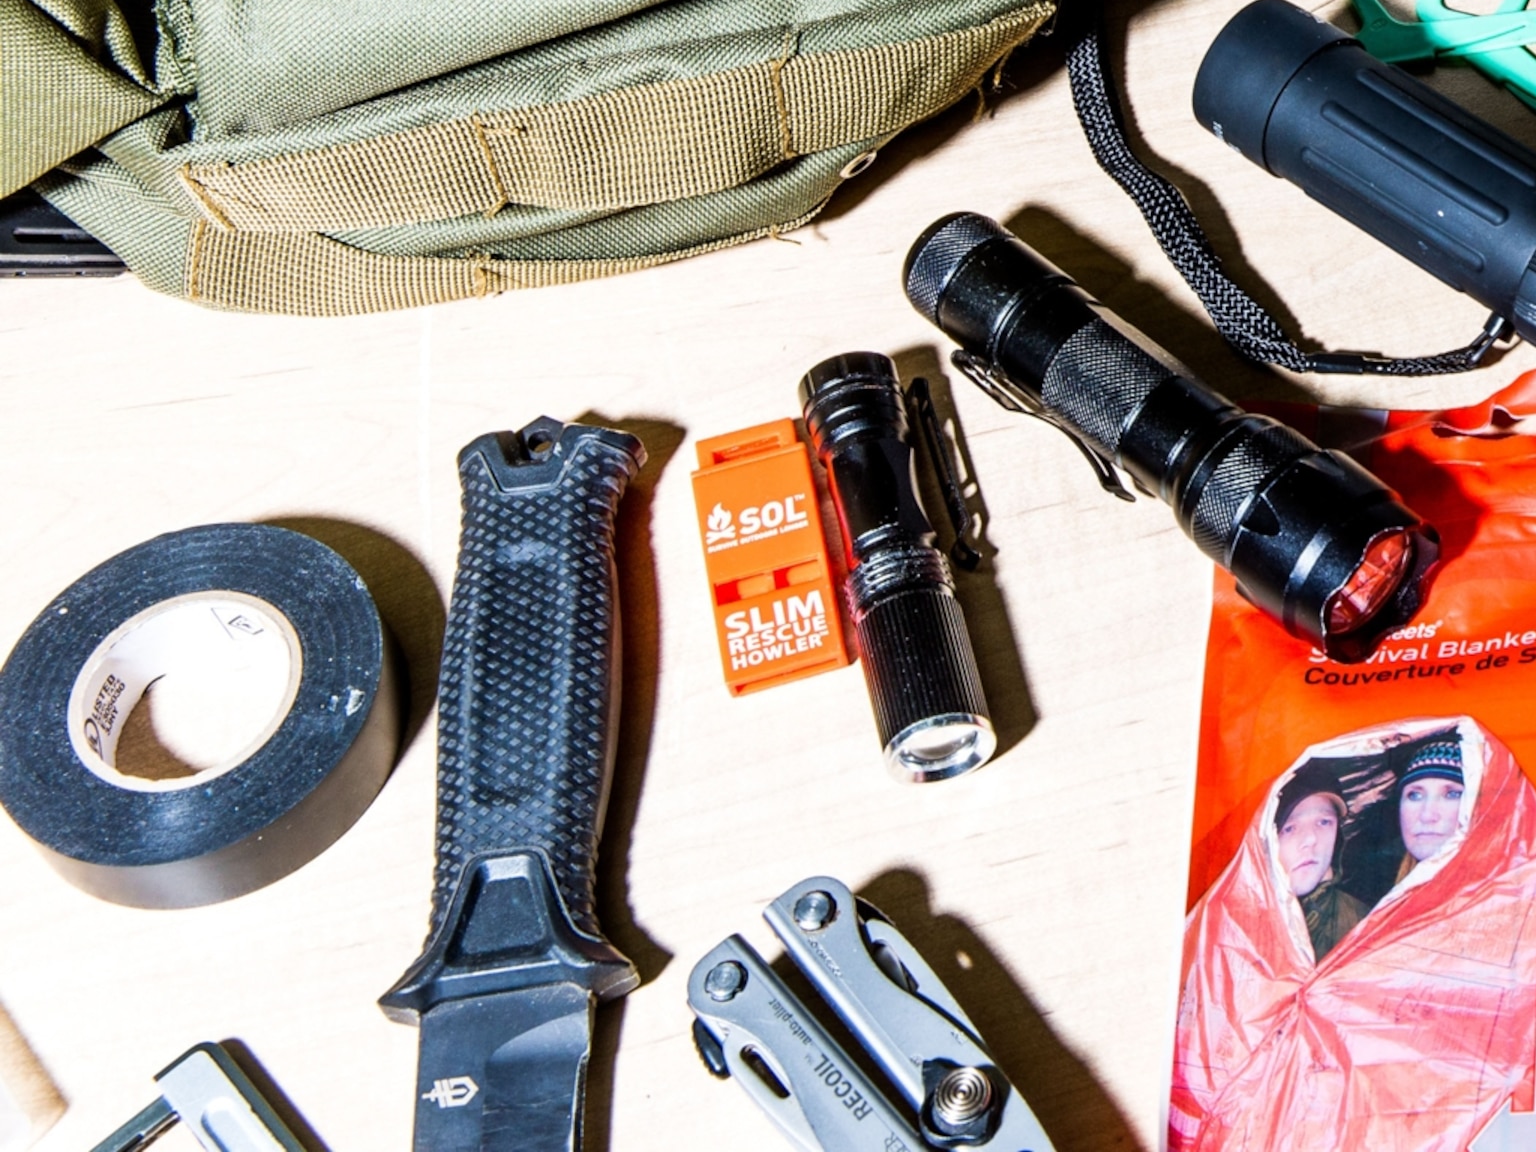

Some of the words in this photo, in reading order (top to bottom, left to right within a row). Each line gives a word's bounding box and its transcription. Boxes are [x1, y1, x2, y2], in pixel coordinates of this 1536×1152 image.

[707, 539, 738, 554] SURVIVE
[739, 527, 778, 546] OUTDOORS
[780, 519, 809, 535] LONGER
[739, 496, 808, 536] SOL
[724, 589, 826, 640] SLIM
[727, 614, 829, 657] RESCUE
[731, 633, 823, 671] HOWLER
[1308, 641, 1428, 664] Svival
[1304, 662, 1466, 686] Couverture
[1475, 654, 1510, 672] de
[91, 674, 116, 720] LISTED
[768, 999, 812, 1045] auto-plier
[813, 1053, 874, 1121] RECOIL
